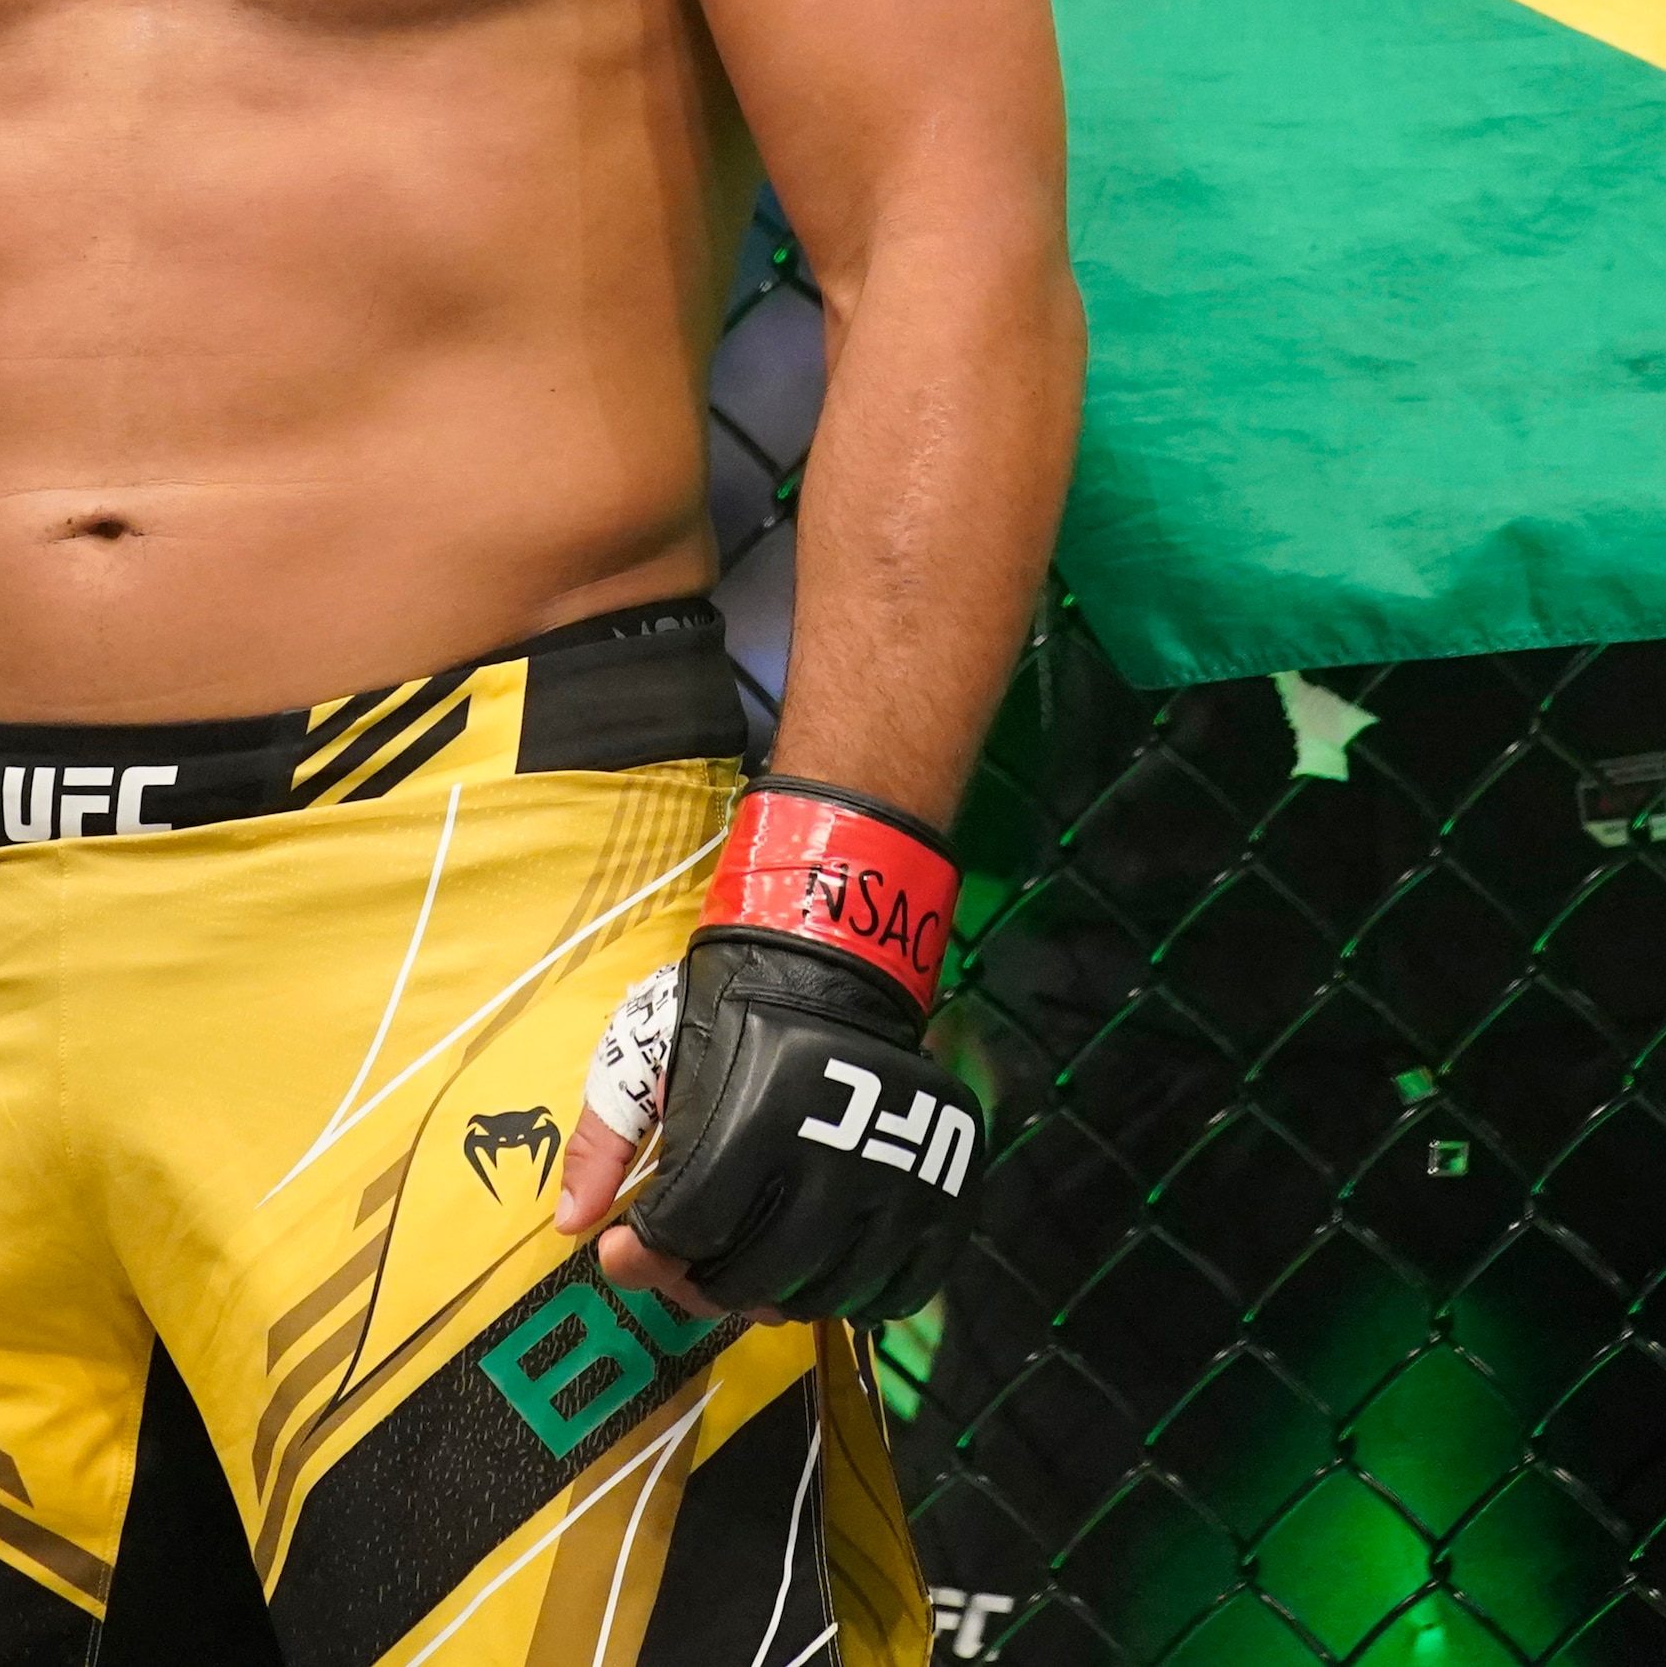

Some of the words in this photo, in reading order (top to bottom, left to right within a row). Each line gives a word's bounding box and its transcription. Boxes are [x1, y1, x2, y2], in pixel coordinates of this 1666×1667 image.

[2, 765, 179, 842] UFC
[801, 861, 940, 974] NSAC
[797, 1058, 976, 1197] UFC
[928, 1587, 1015, 1662] FC
